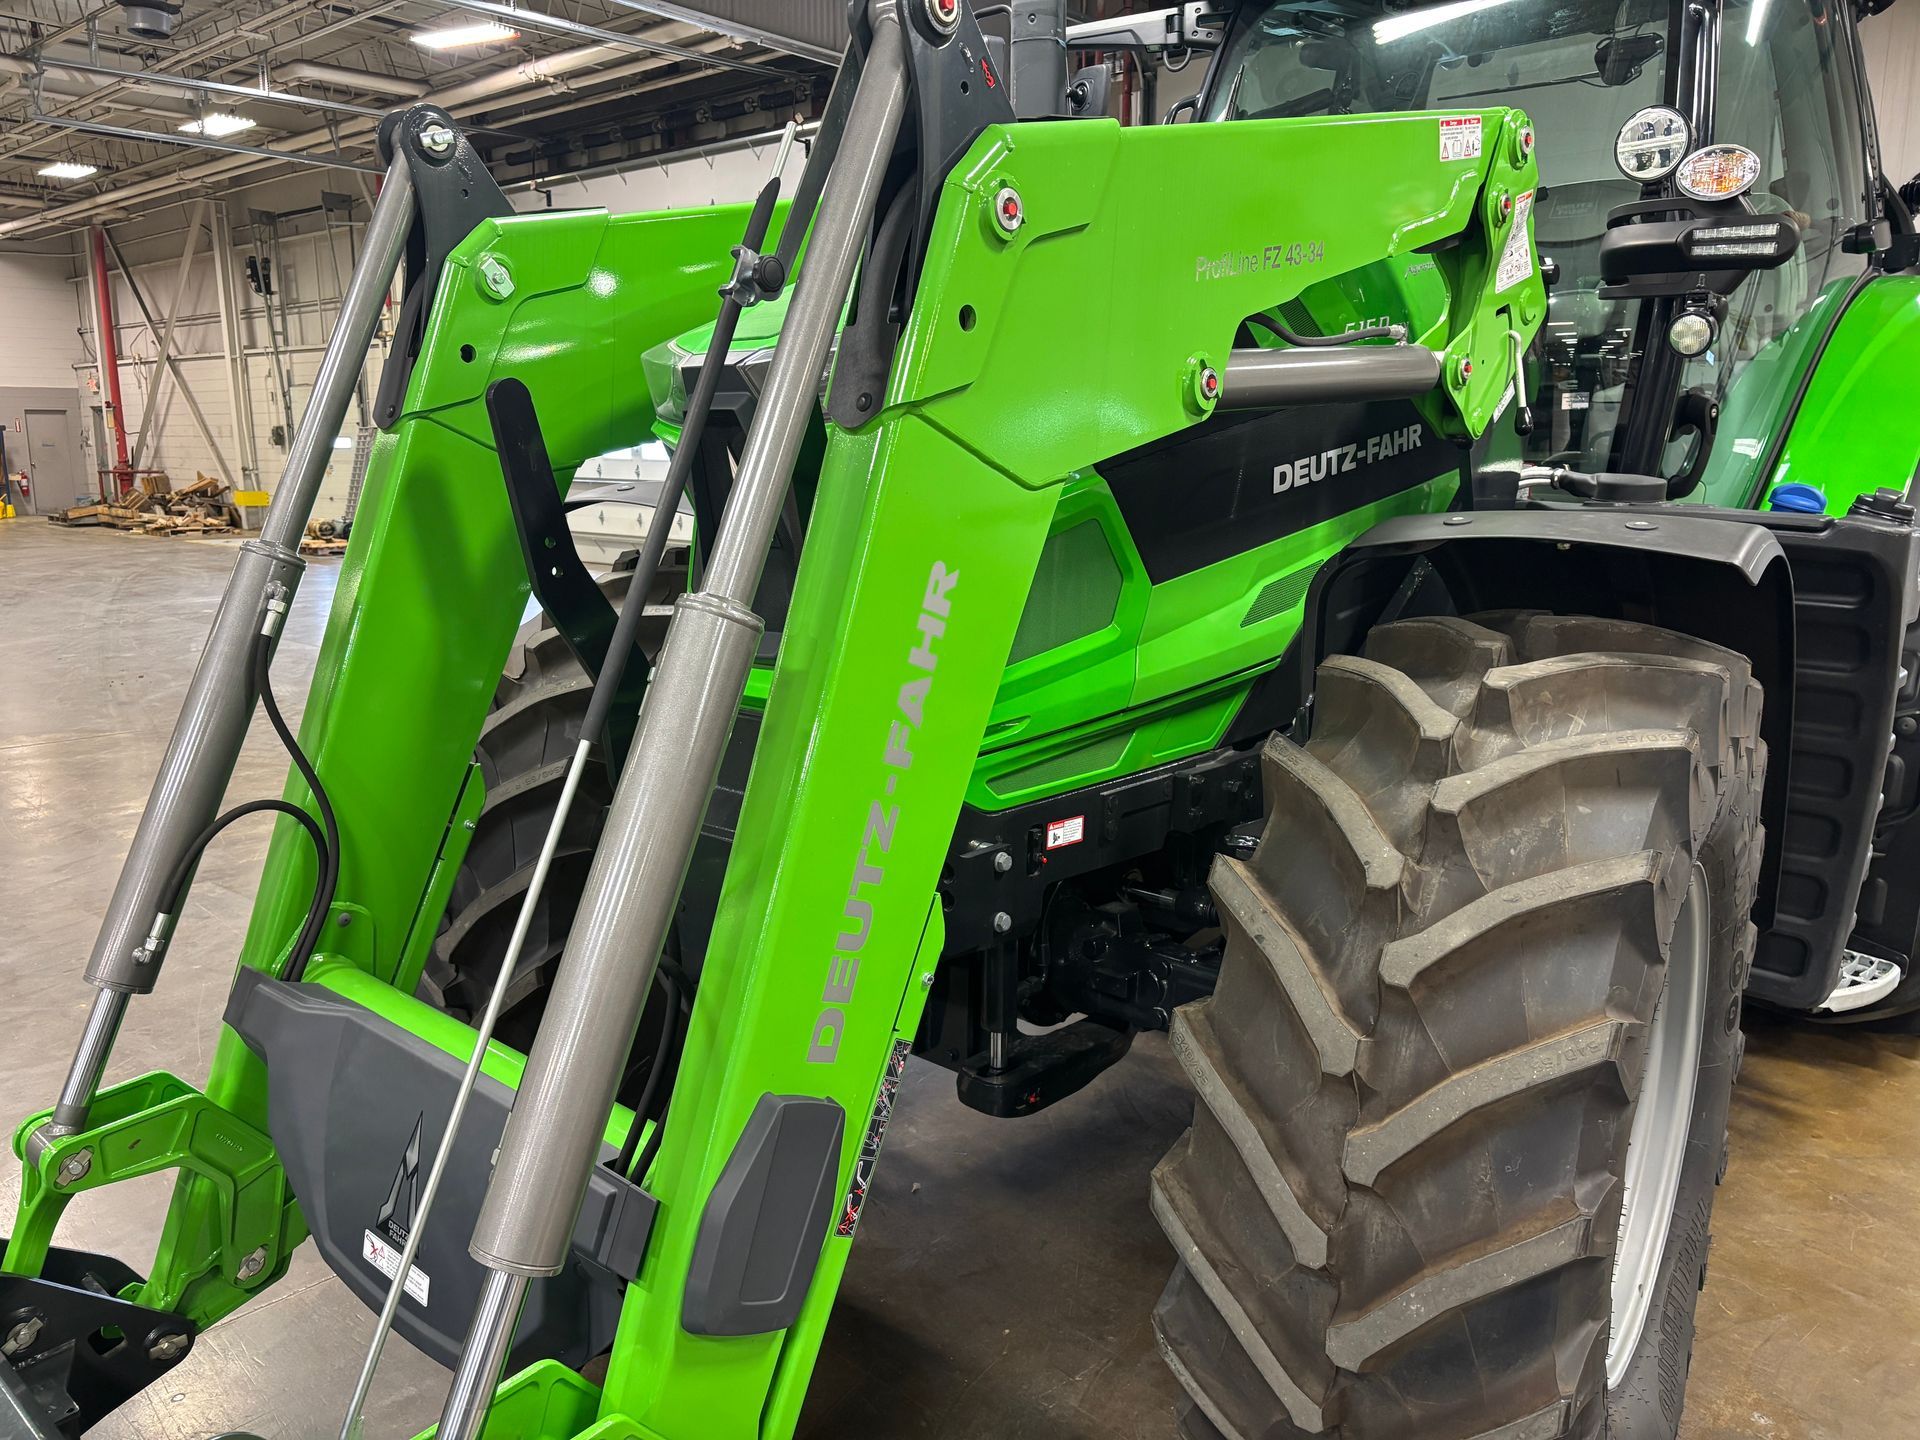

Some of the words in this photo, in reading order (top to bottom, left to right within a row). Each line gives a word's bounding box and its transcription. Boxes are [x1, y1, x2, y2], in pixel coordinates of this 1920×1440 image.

[1195, 250, 1259, 282] ProfiLine
[1263, 245, 1282, 270] FZ
[1285, 240, 1324, 266] 43-34
[1273, 424, 1422, 494] DEUTZ-FAHR
[806, 560, 960, 1064] DEUTZ-FAHR
